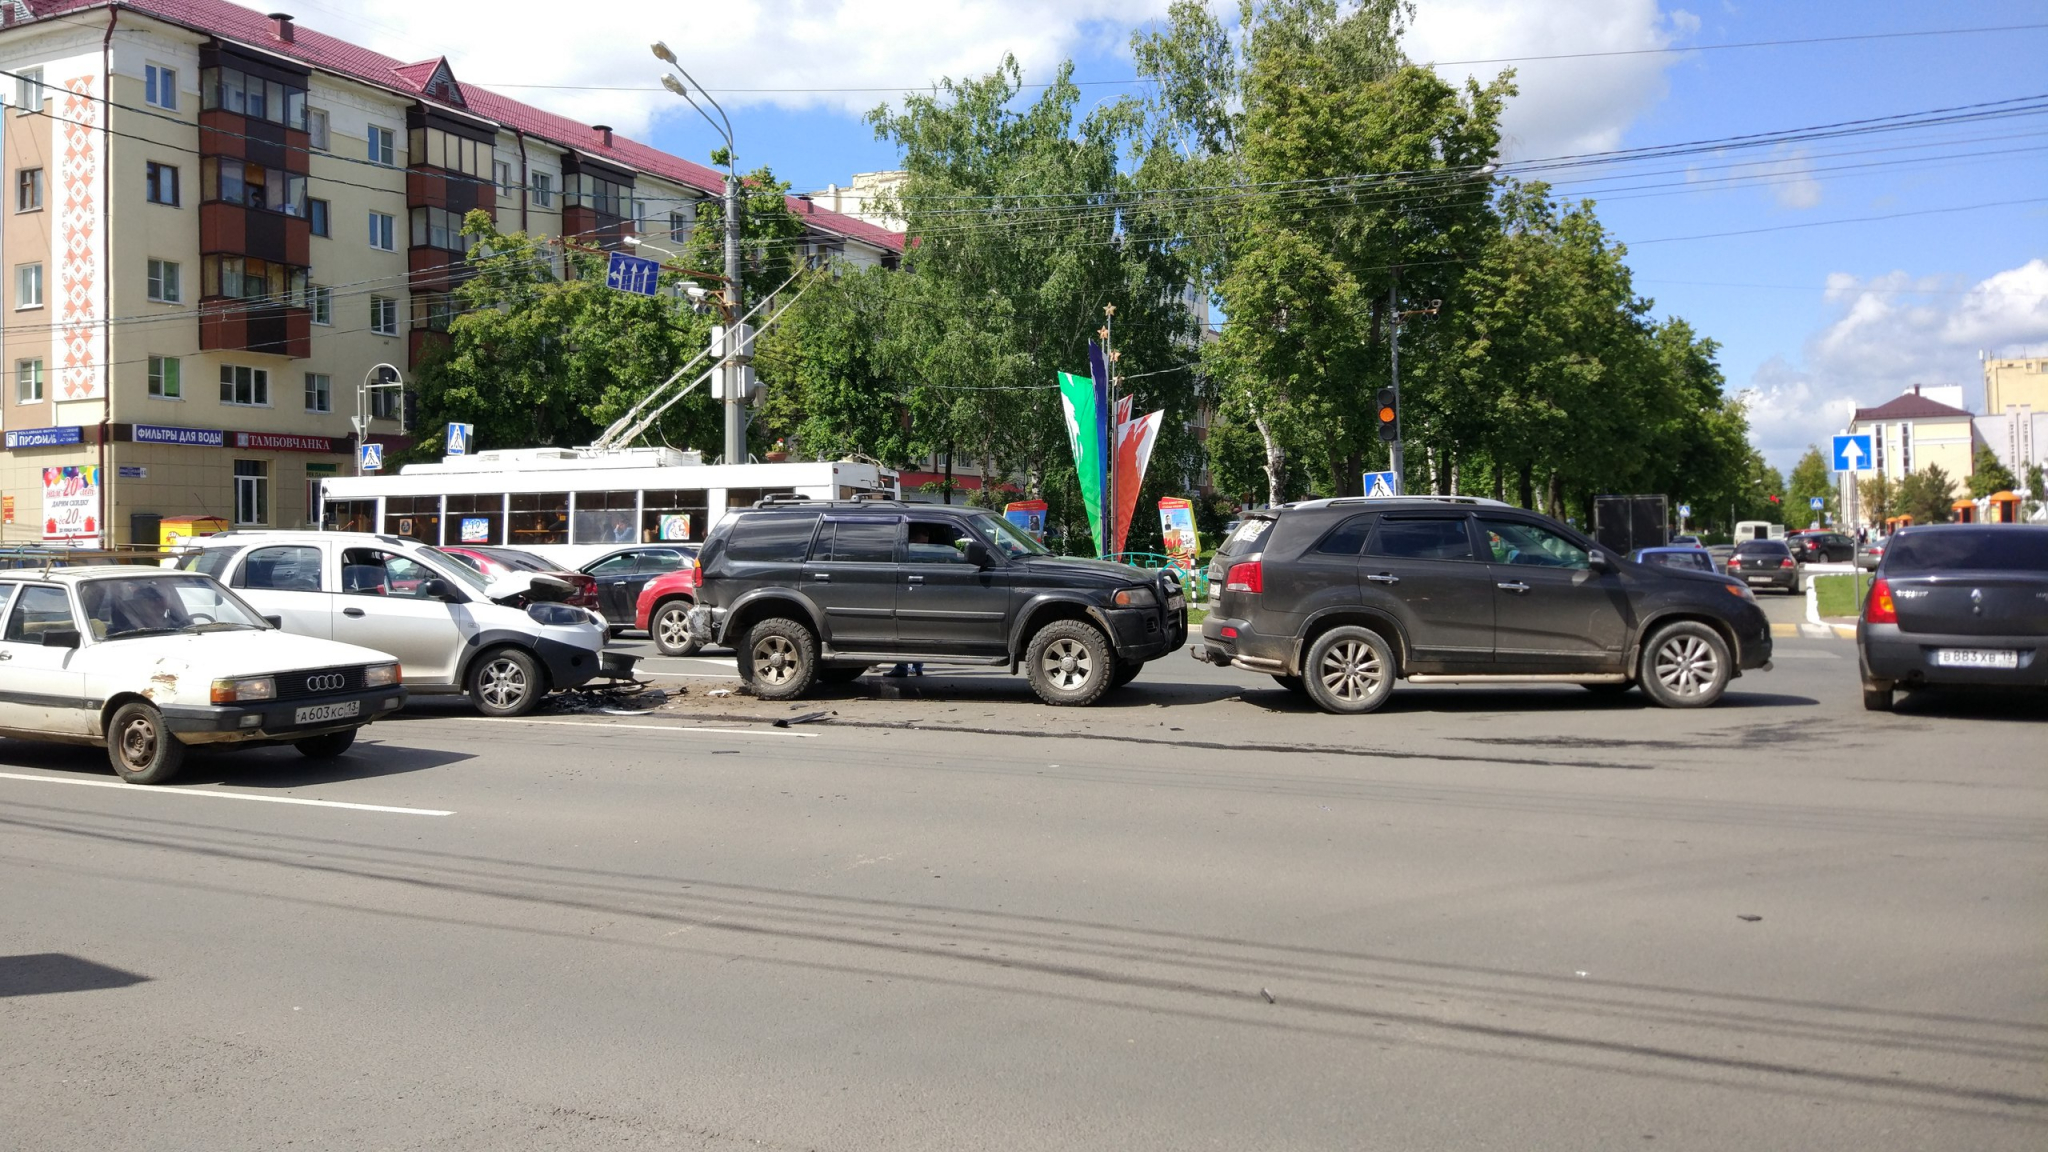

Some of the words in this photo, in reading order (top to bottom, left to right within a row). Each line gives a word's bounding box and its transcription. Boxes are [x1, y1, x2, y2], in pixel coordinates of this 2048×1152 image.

[19, 433, 57, 446] ПРОФИЛЬ
[137, 428, 178, 441] ФИЛЬТРЫ
[179, 431, 196, 443] ДЛЯ
[198, 432, 222, 444] ВОДЫ
[249, 435, 330, 450] ТАМБОВЧАНКА
[63, 477, 79, 497] 20
[65, 508, 79, 525] 20
[300, 706, 344, 721] А603КС
[346, 701, 357, 711] 13
